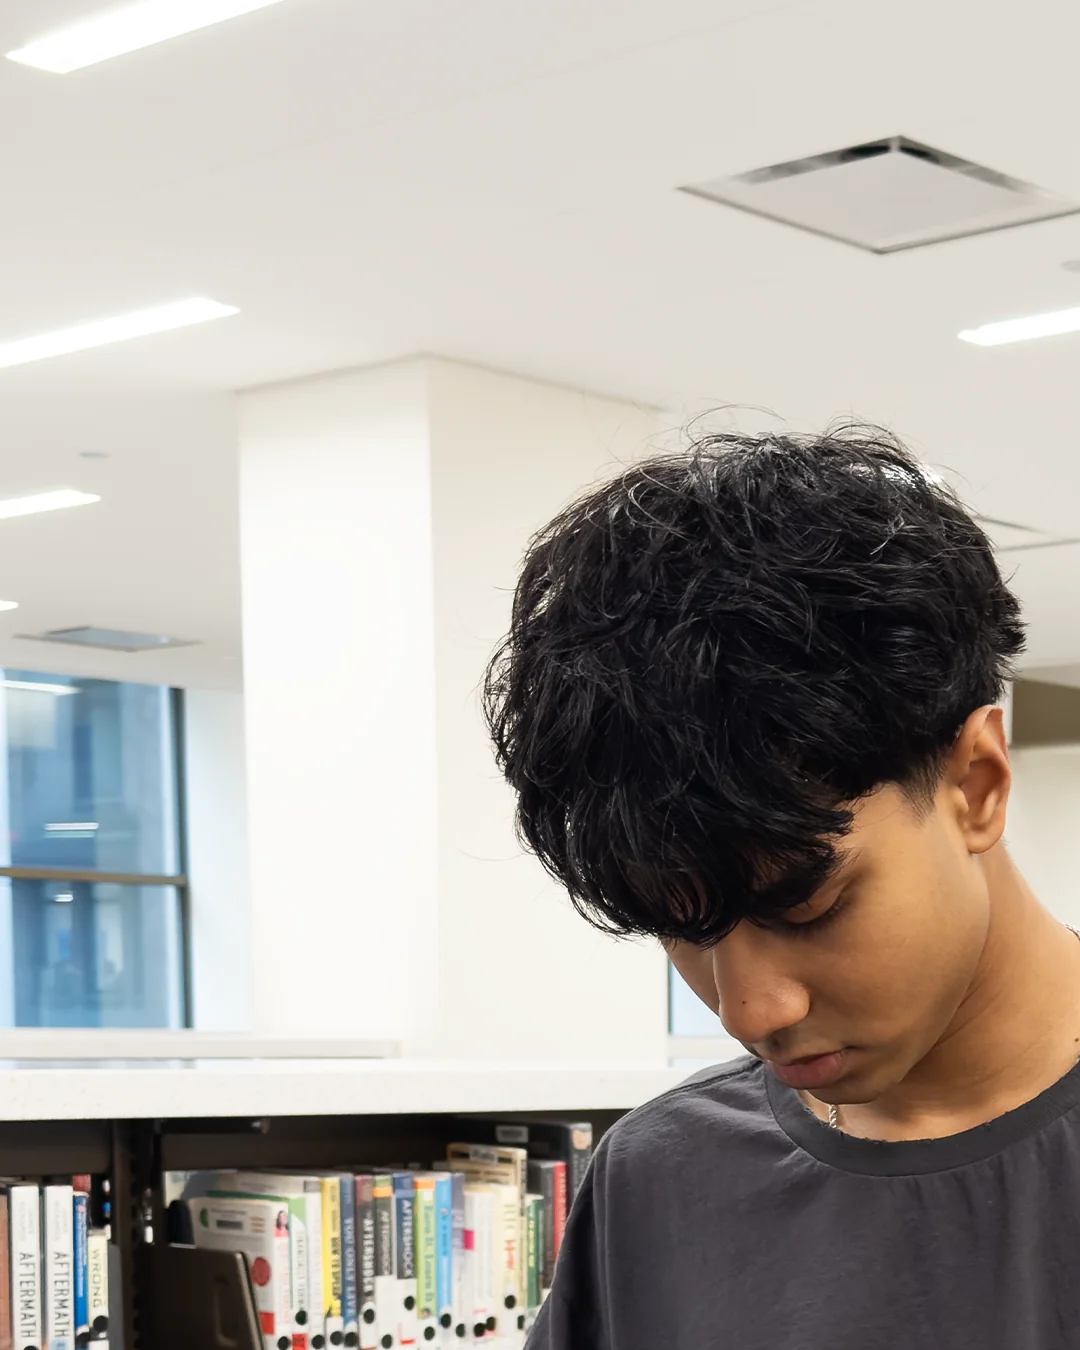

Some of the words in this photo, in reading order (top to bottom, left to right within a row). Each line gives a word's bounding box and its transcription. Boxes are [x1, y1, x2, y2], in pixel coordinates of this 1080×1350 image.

[363, 1218, 374, 1292] AFTERSHOCK
[402, 1200, 413, 1278] AFTERSHOCK
[19, 1252, 36, 1338] AFTERMATH
[54, 1251, 70, 1338] AFTERMATH
[92, 1249, 102, 1308] WRONG
